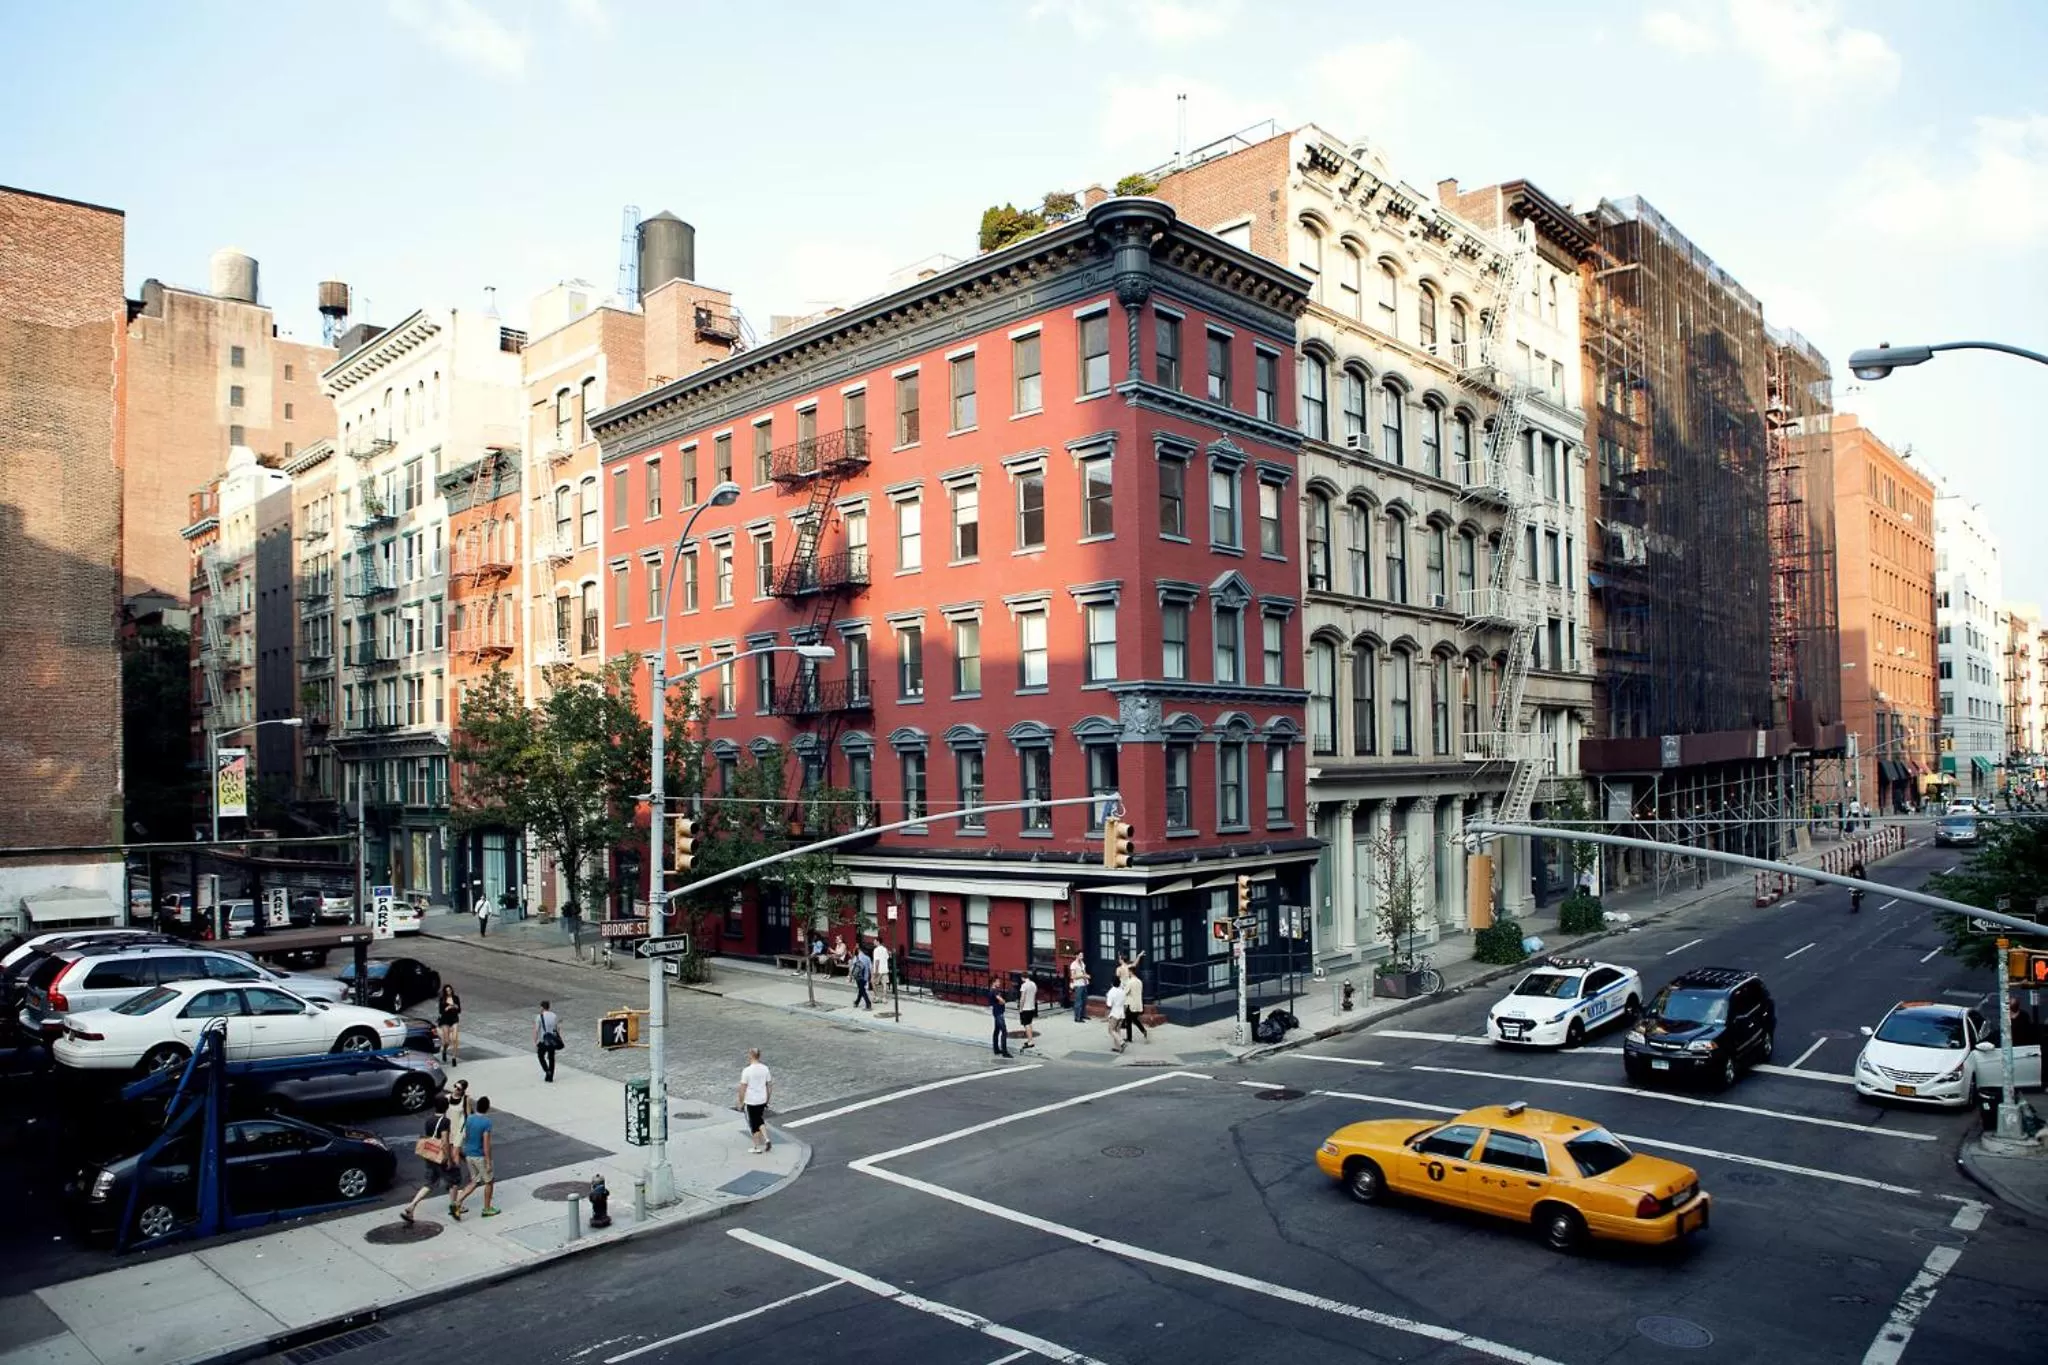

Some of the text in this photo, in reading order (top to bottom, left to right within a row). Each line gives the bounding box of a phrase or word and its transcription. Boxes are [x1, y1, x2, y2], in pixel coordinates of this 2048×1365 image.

[273, 889, 284, 915] PARK
[378, 897, 388, 927] PARK
[601, 922, 648, 936] BROOME ST
[642, 940, 681, 954] ONE WAY
[1431, 1165, 1441, 1179] T
